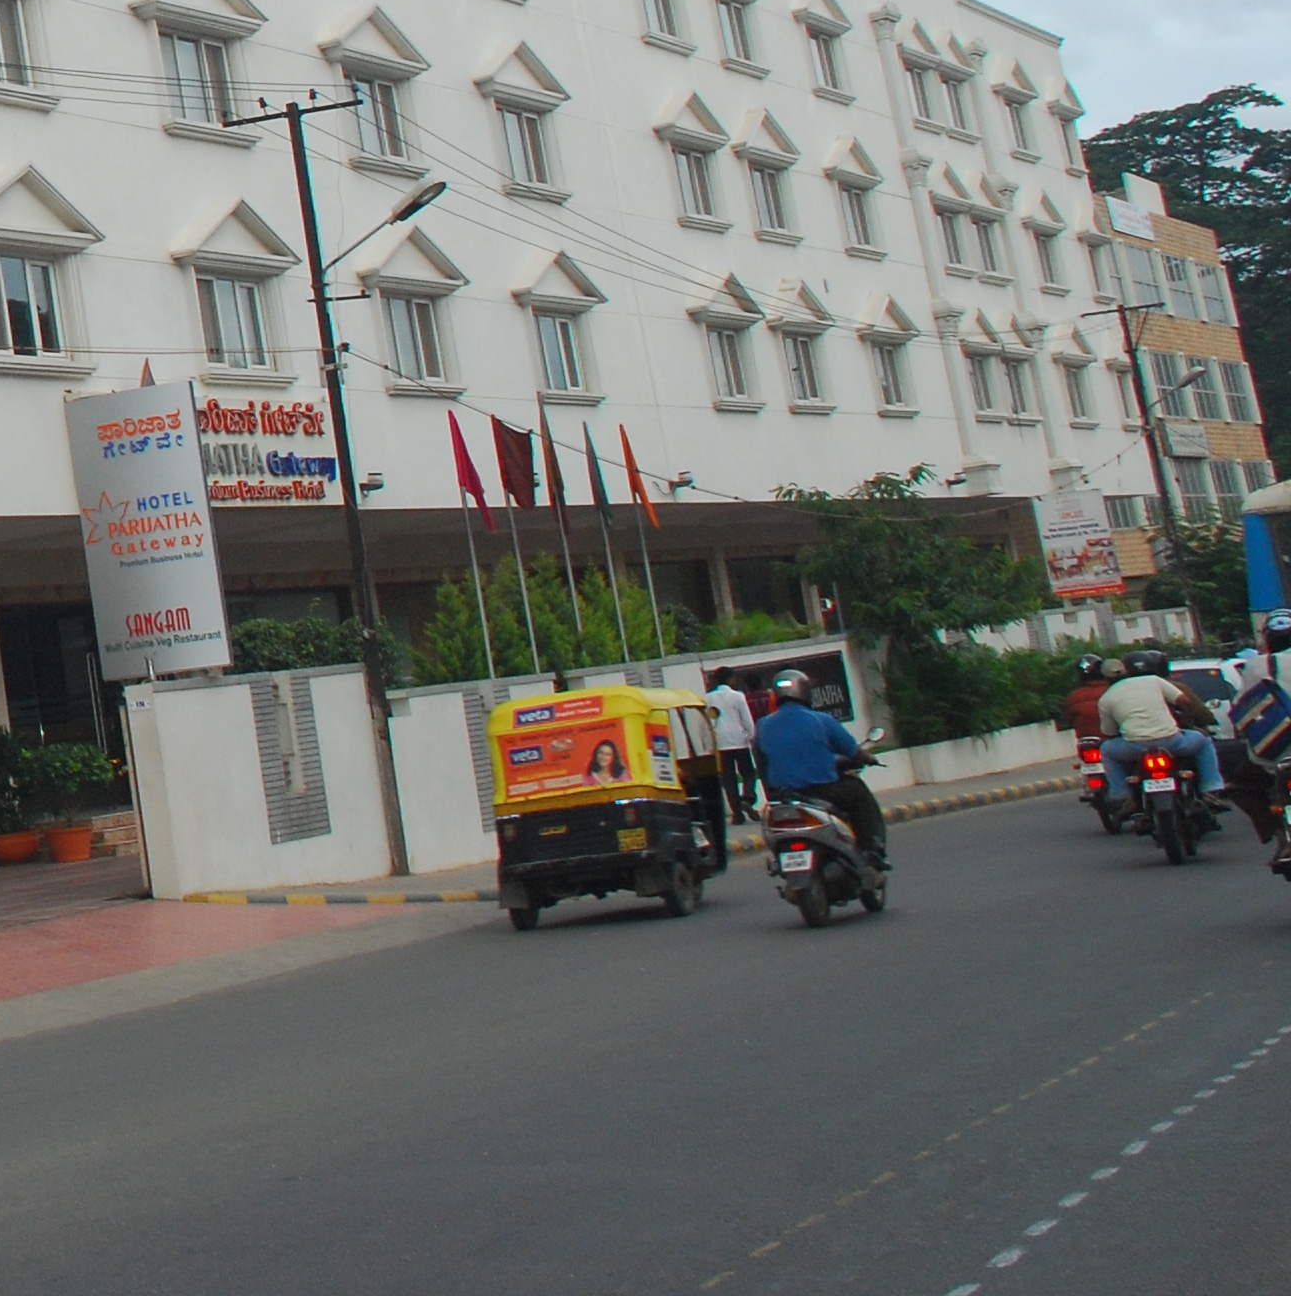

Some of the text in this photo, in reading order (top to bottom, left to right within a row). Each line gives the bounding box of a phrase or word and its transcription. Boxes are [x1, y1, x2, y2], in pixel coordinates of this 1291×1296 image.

[96, 409, 182, 442] ಪಾರಿಜಾತ
[136, 491, 193, 512] HOTEL
[107, 512, 202, 540] PARIJATHA
[111, 533, 204, 556] Gateway
[150, 554, 183, 564] Business
[184, 550, 204, 559] Hotel
[125, 607, 191, 638] SANGAM
[155, 636, 173, 647] Veg
[173, 630, 222, 644] Restaurant
[135, 700, 145, 708] IN
[519, 709, 550, 723] veta
[510, 748, 540, 763] veta
